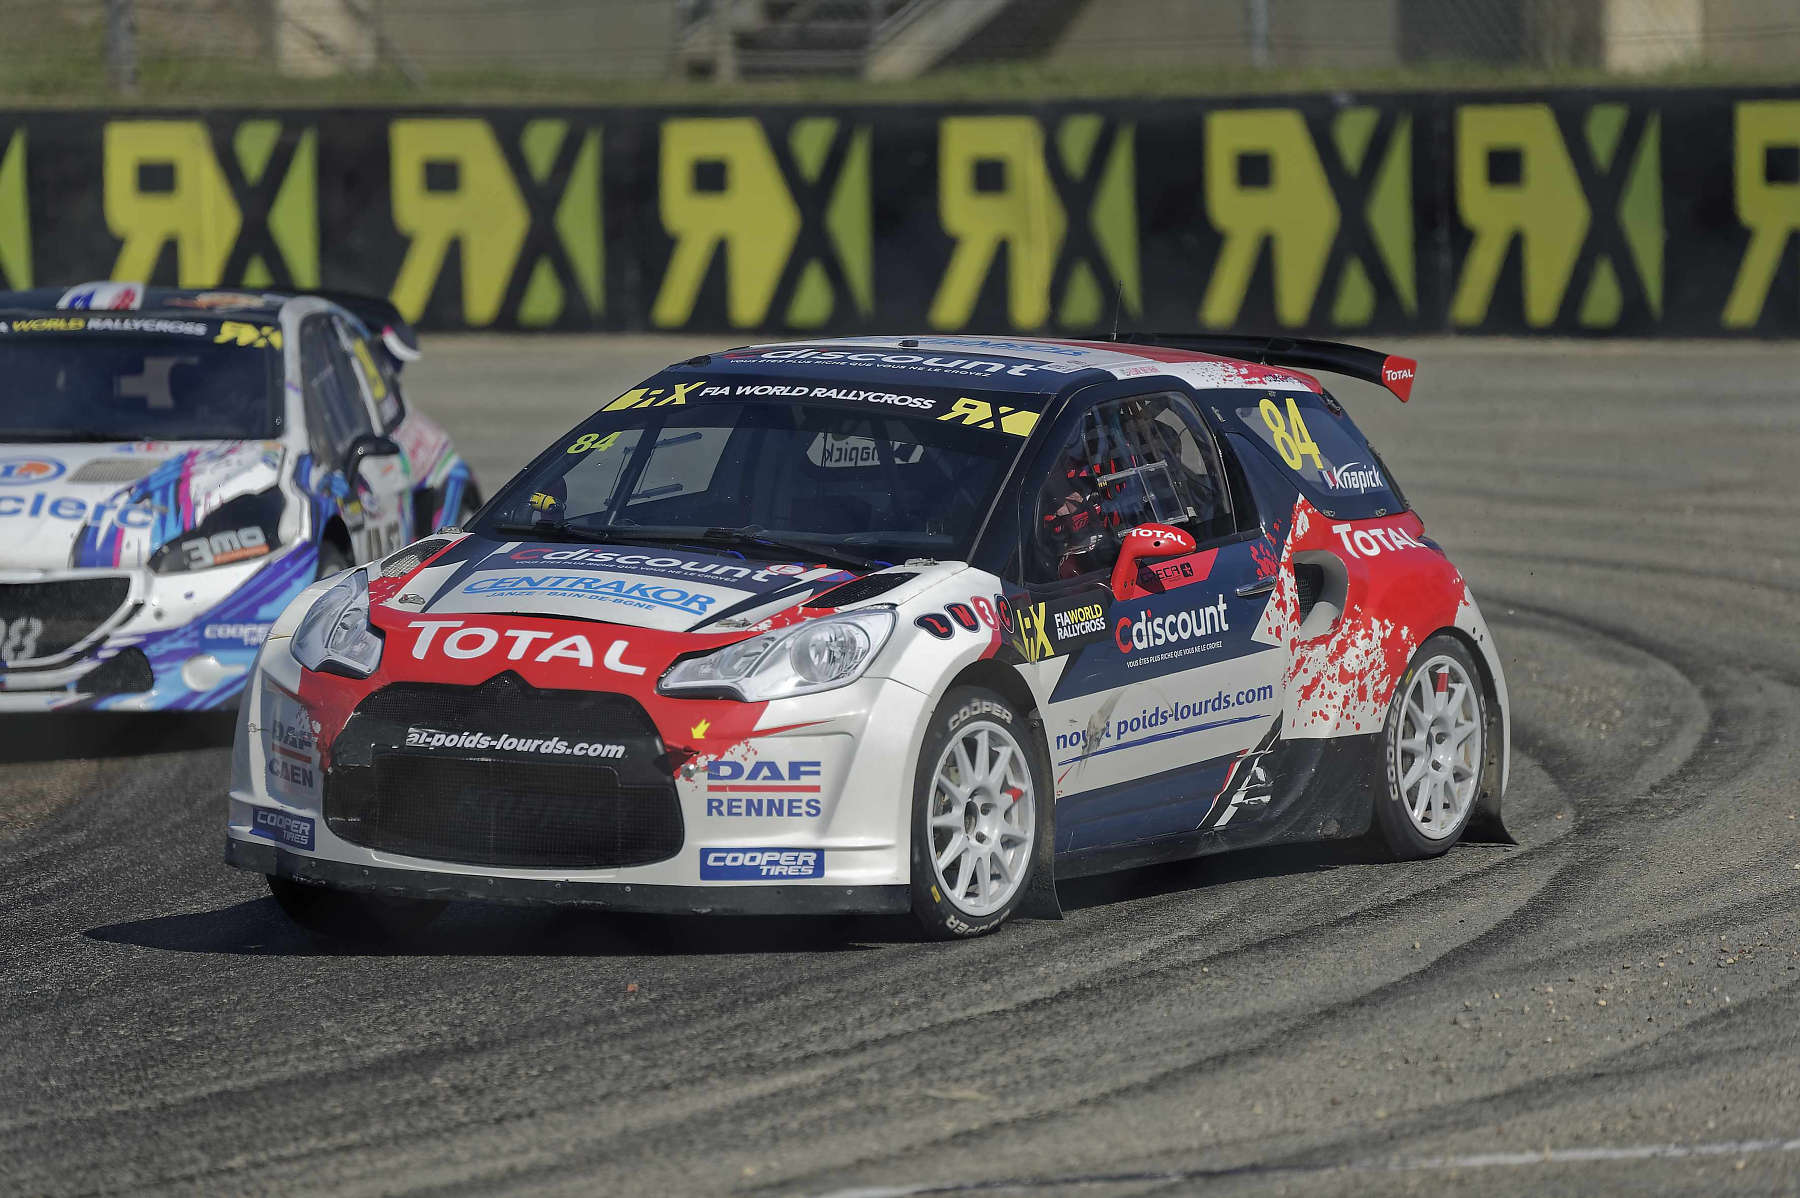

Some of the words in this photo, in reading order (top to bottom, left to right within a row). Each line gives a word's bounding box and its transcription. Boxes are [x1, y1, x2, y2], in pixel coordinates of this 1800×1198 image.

[1722, 103, 1800, 327] R
[12, 317, 85, 331] WORLD
[87, 317, 207, 336] RALLYCROSS
[699, 386, 730, 396] FIA
[735, 385, 809, 396] WORLD
[810, 387, 937, 409] RALLYCROSS
[567, 431, 623, 454] 84
[1259, 397, 1324, 471] 84
[1330, 462, 1384, 493] Knapick
[1131, 527, 1187, 546] TOTAL
[1332, 523, 1428, 559] TOTAL
[510, 548, 778, 583] Cdiscount
[463, 576, 717, 614] CENTRAKOR
[1057, 617, 1106, 641] RALLYCROSS
[1115, 594, 1229, 654] Cdiscount
[408, 620, 648, 676] TOTAL
[948, 699, 1013, 731] COOPER
[1116, 684, 1273, 740] poids-lourds.com
[269, 757, 314, 788] CAEN
[707, 760, 822, 781] DAF
[706, 798, 821, 817] RENNES
[257, 810, 311, 836] COOPER
[282, 829, 309, 845] TIRES
[706, 852, 817, 866] COOPER
[760, 865, 815, 876] TIRES
